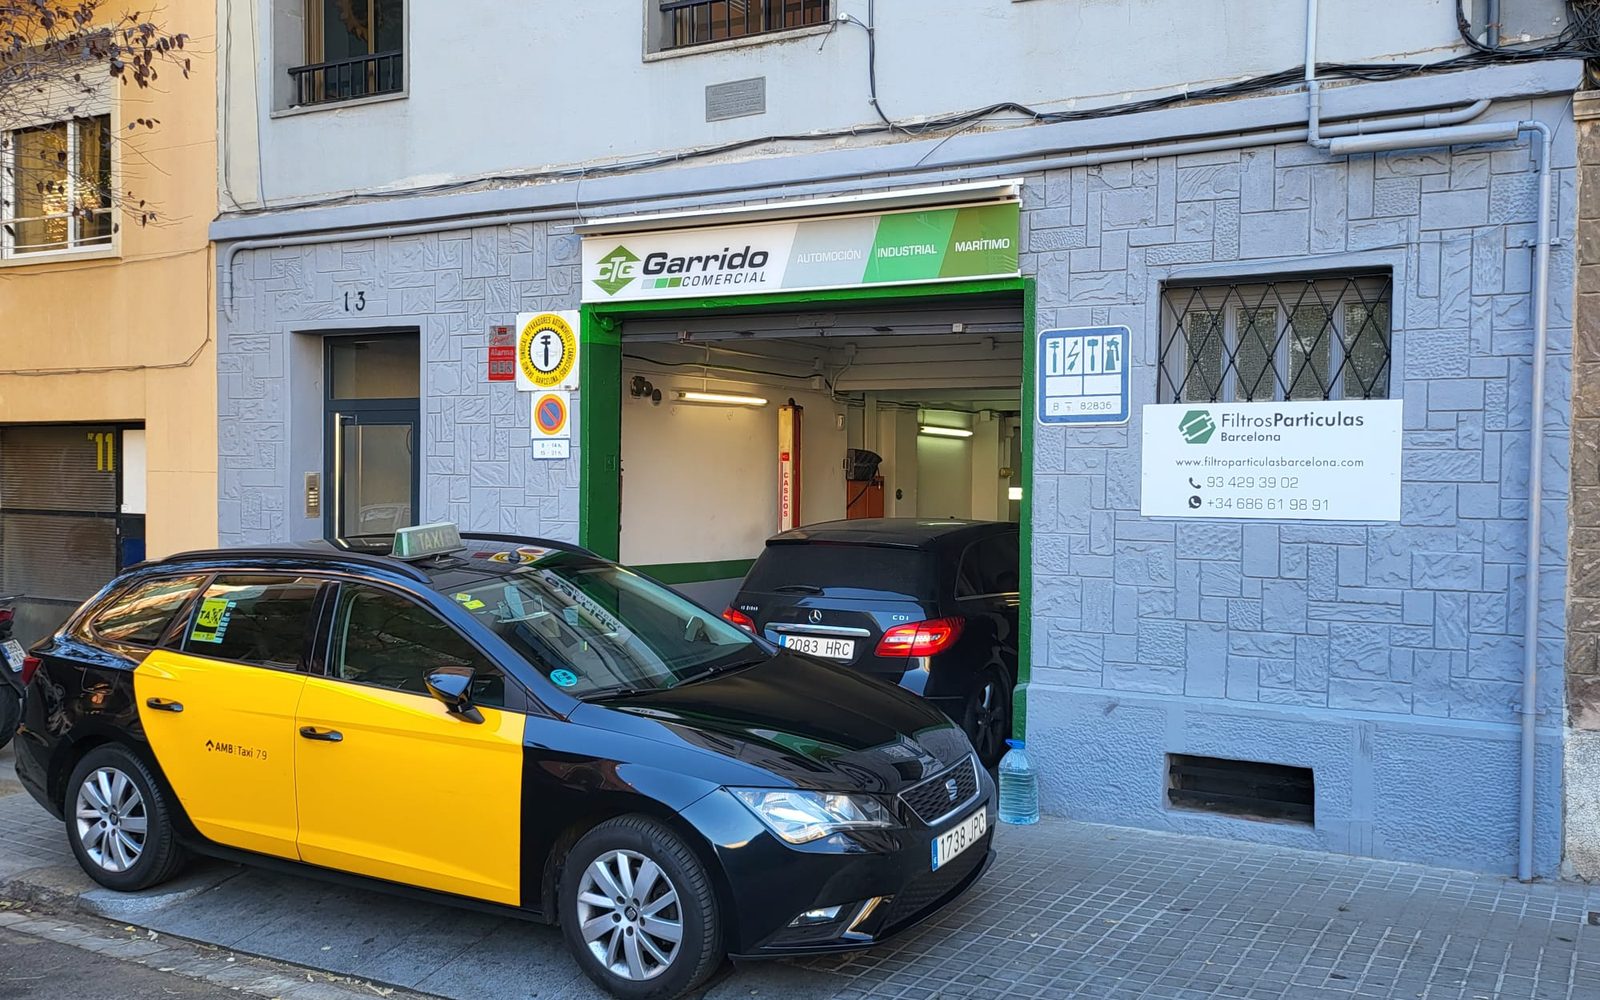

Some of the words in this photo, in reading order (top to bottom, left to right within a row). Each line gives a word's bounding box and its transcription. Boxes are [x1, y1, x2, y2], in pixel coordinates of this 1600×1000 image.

[877, 244, 938, 258] INDUSTRIAL
[955, 238, 1010, 252] MARÍTIMO
[643, 245, 769, 275] Garrido
[797, 248, 861, 264] AUTOMOCIÓN
[682, 271, 766, 288] COMERCIAL
[344, 291, 366, 311] 13
[1080, 401, 1112, 410] 82836
[1221, 411, 1364, 428] FiltrosParticulas
[1221, 432, 1281, 442] Barcelona
[95, 433, 113, 471] 11
[1175, 456, 1364, 469] www.filtroparticulasbarcelona.com
[1206, 476, 1224, 488] 93
[1227, 476, 1255, 488] 429
[1258, 476, 1276, 488] 39
[1280, 477, 1299, 489] 02
[1206, 498, 1233, 509] +34
[1236, 498, 1263, 510] 686
[1267, 498, 1283, 510] 61
[1289, 499, 1307, 510] 98
[1311, 499, 1329, 511] 91
[416, 528, 445, 550] TAXI
[788, 638, 819, 653] 2083
[825, 641, 850, 656] HRC
[215, 742, 233, 754] AMB
[238, 745, 254, 758] Taxi
[256, 749, 268, 761] 79
[941, 826, 966, 861] 1738
[968, 813, 985, 842] JPC
